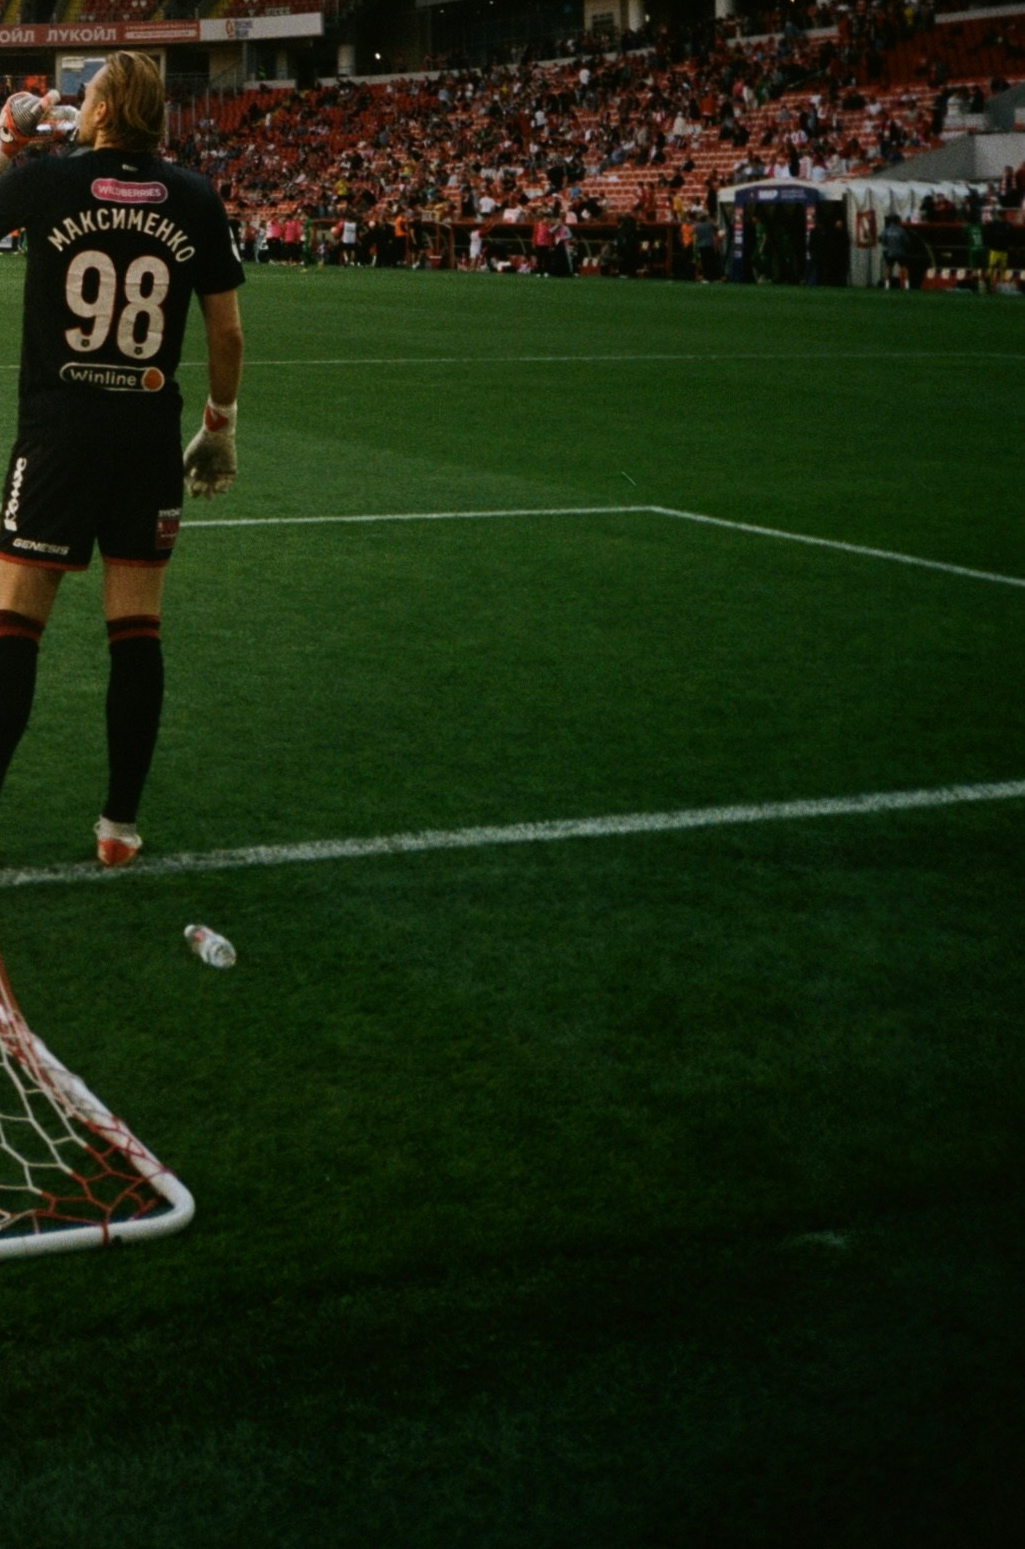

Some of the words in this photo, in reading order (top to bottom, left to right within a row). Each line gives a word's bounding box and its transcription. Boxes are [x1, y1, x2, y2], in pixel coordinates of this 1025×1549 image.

[46, 26, 117, 42] ЛУКОЙЛ
[98, 185, 162, 197] WILDBERRIES
[47, 208, 196, 262] МАКСИМЕНКО
[64, 249, 171, 360] 98
[69, 368, 137, 386] Winline
[12, 537, 71, 555] GENESIS
